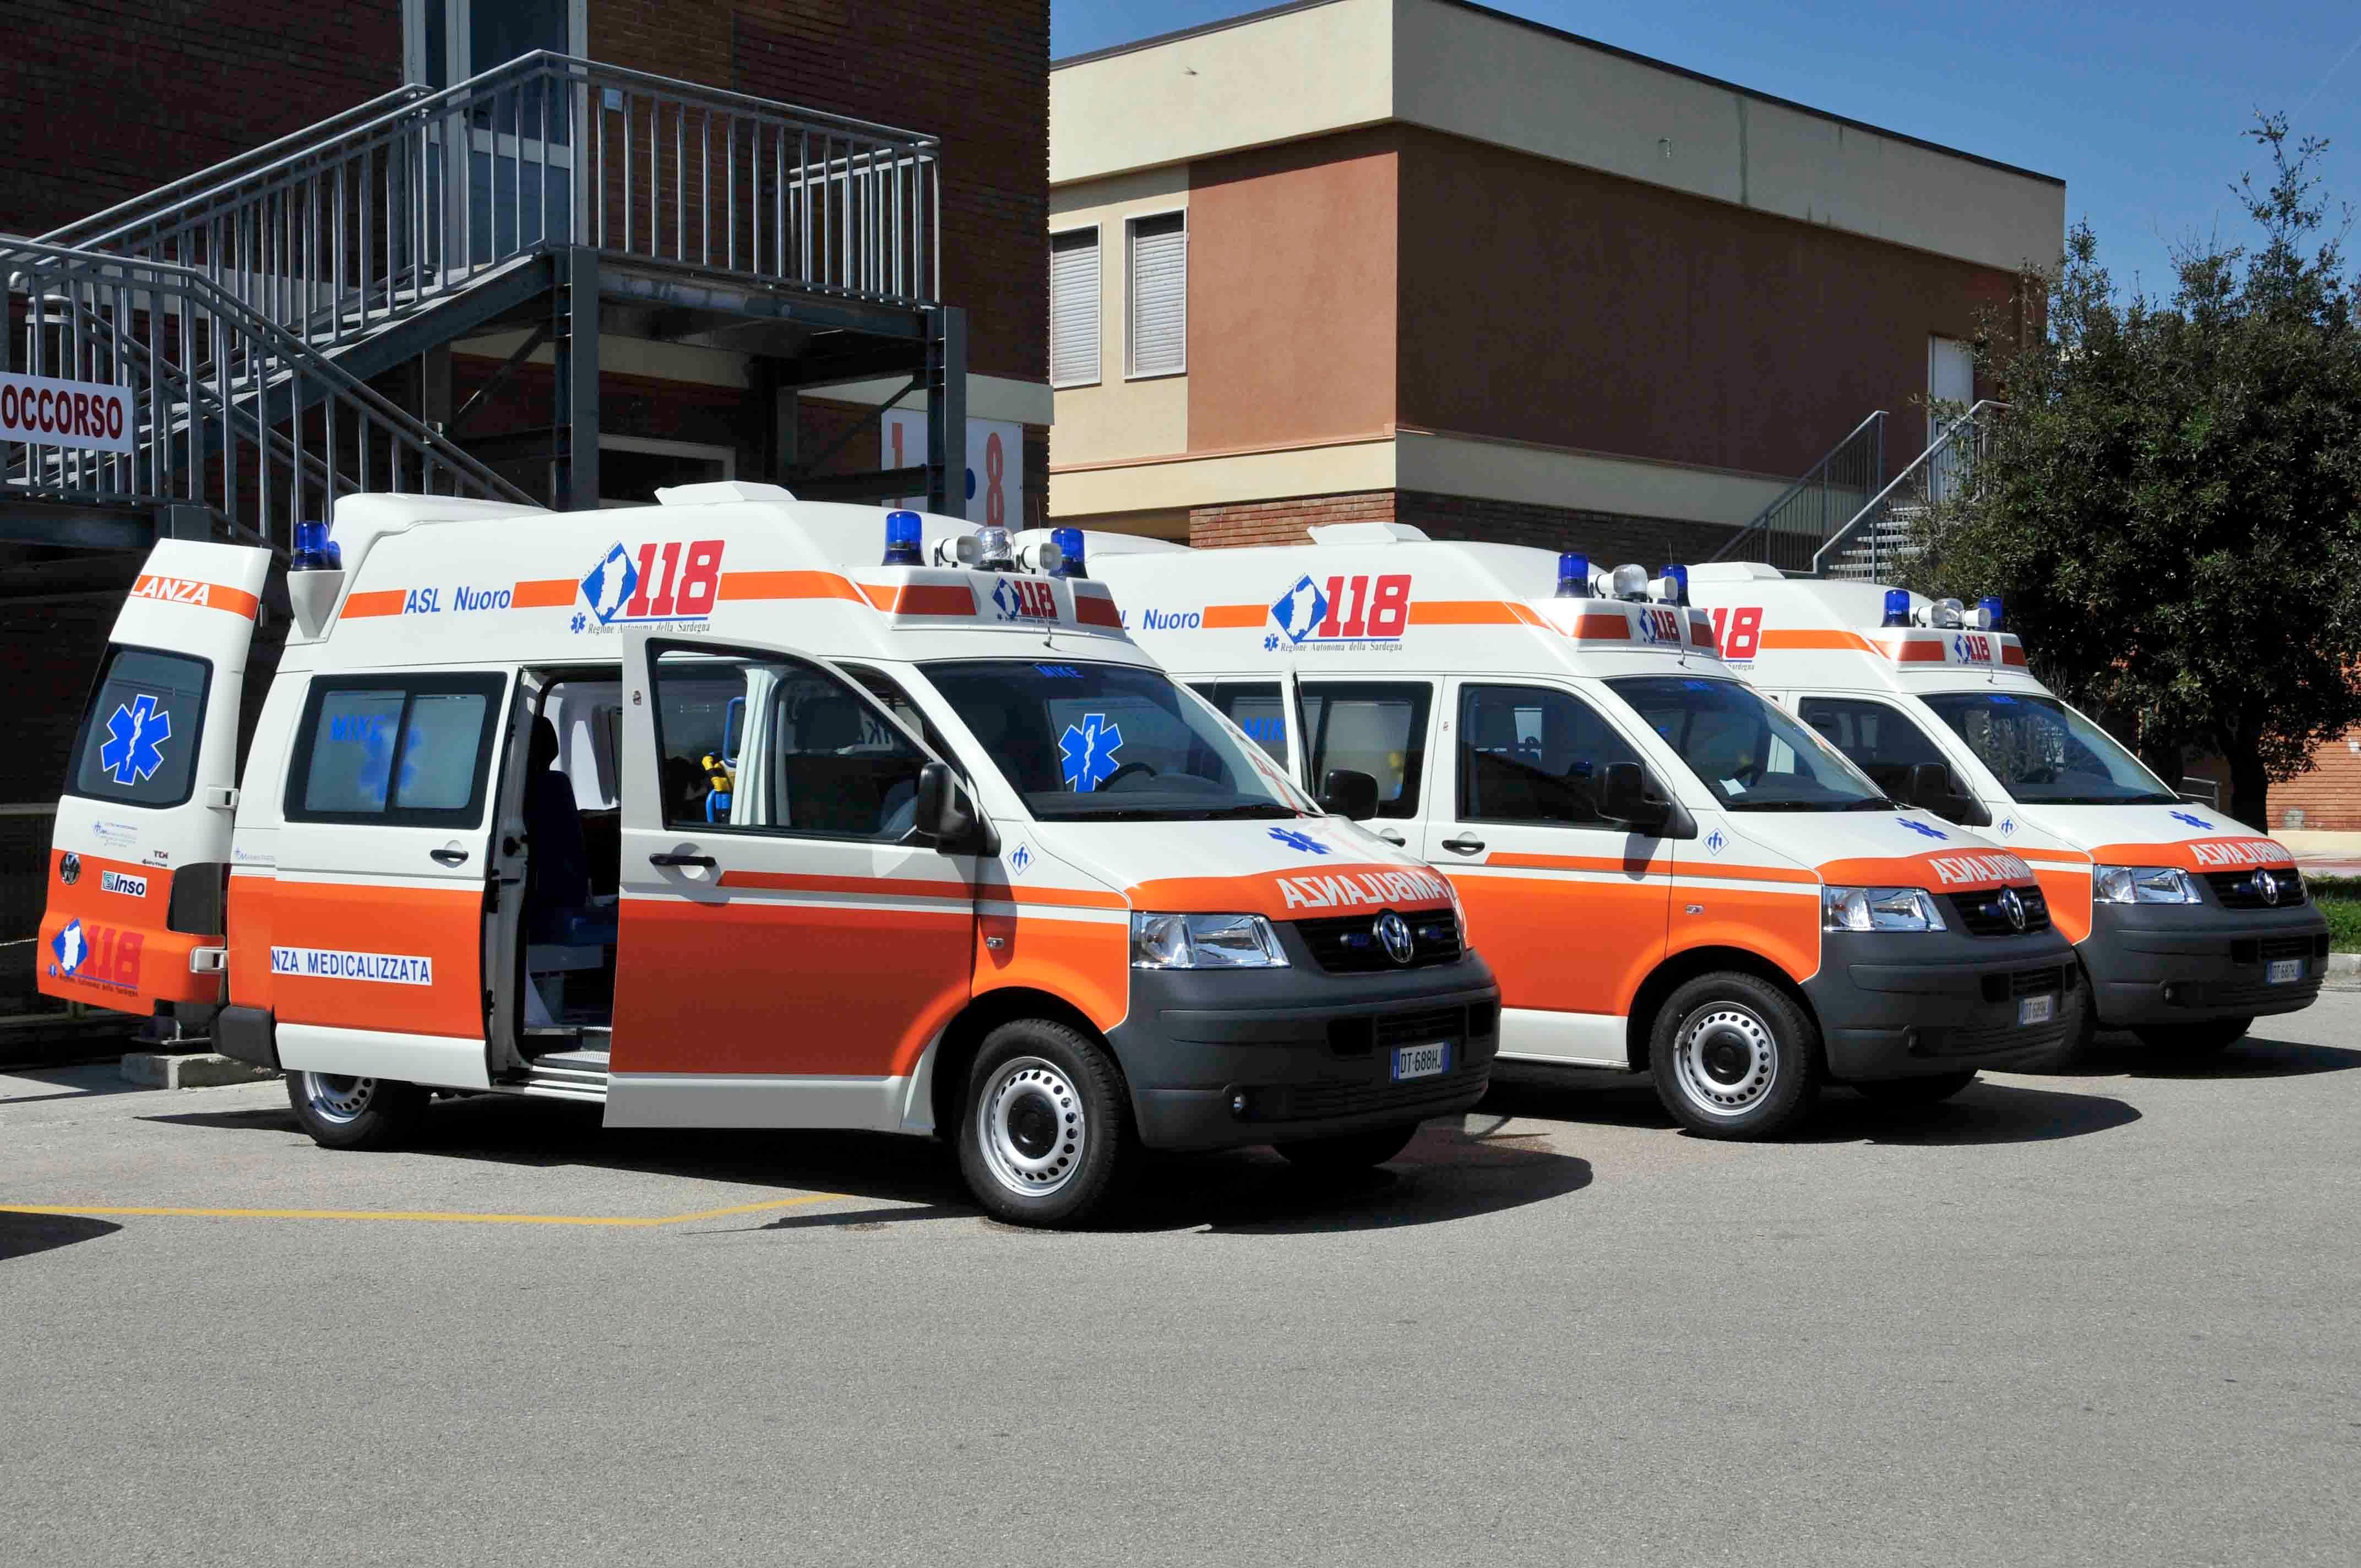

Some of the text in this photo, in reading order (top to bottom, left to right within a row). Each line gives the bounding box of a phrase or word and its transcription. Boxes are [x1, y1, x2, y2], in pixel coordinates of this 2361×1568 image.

[2, 384, 123, 439] OCCORSO
[626, 540, 725, 617] 118
[404, 586, 511, 614] ASL Nuoro
[1014, 580, 1058, 617] 118
[1318, 574, 1412, 637] 118
[588, 623, 615, 636] Regione
[656, 621, 674, 633] della
[677, 620, 711, 634] Sardegna
[1143, 608, 1200, 629] Nuoro
[1651, 610, 1681, 640] 118
[1702, 607, 1763, 658] 18
[1281, 641, 1402, 653] Regione Autonoma della Sardegna
[1966, 636, 1992, 660] 118
[114, 874, 145, 895] Inso
[83, 924, 144, 987] 118
[271, 949, 430, 982] NZA MEDICALIZZATA
